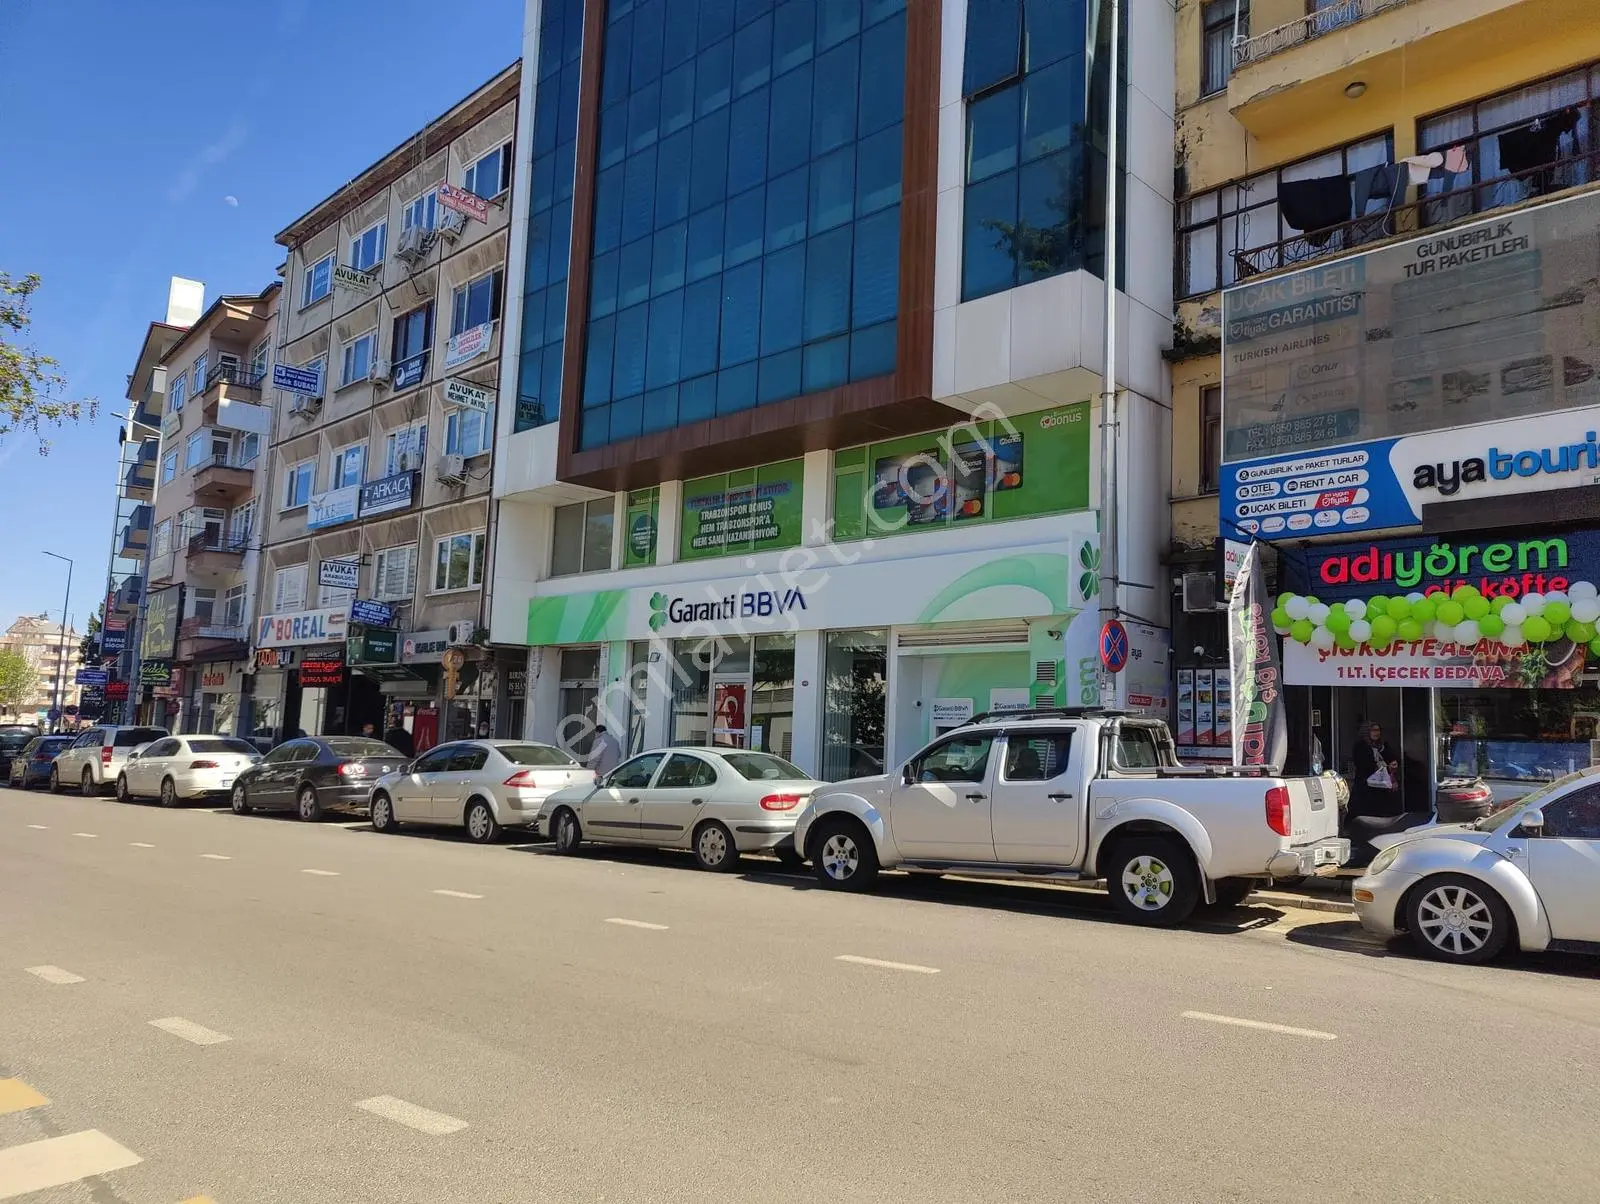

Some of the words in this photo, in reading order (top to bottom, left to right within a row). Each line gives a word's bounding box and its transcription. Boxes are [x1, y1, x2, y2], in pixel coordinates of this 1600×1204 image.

[1416, 221, 1513, 258] GÜNÜBİRLİK
[1404, 260, 1435, 278] TUR
[1440, 235, 1529, 269] PAKETLERİ
[335, 268, 371, 285] AVUKAT
[1233, 345, 1278, 364] TURKISH
[1282, 334, 1331, 352] AIRLINES
[448, 391, 468, 403] MEHMET
[450, 383, 486, 400] AVUKAT
[1305, 460, 1330, 469] PAKET
[1333, 455, 1364, 466] TURLAR
[1413, 431, 1600, 496] ayatouri
[1251, 483, 1274, 493] OTEL
[1300, 479, 1325, 489] RENT
[1328, 477, 1335, 485] A
[1339, 473, 1359, 484] CAR
[1250, 502, 1276, 515] UÇAK
[1278, 499, 1307, 511] BİLETİ
[701, 524, 715, 534] HEM
[693, 536, 707, 548] HEM
[323, 564, 358, 576] AVUKAT
[1320, 539, 1568, 587] adıyörem
[669, 595, 734, 623] Garanti
[741, 586, 806, 617] BBVA
[276, 615, 326, 640] BOREAL
[1337, 667, 1344, 678] 1
[1347, 667, 1366, 678] LT.
[1370, 663, 1430, 682] İÇECEK
[1434, 665, 1506, 680] BEDAVA
